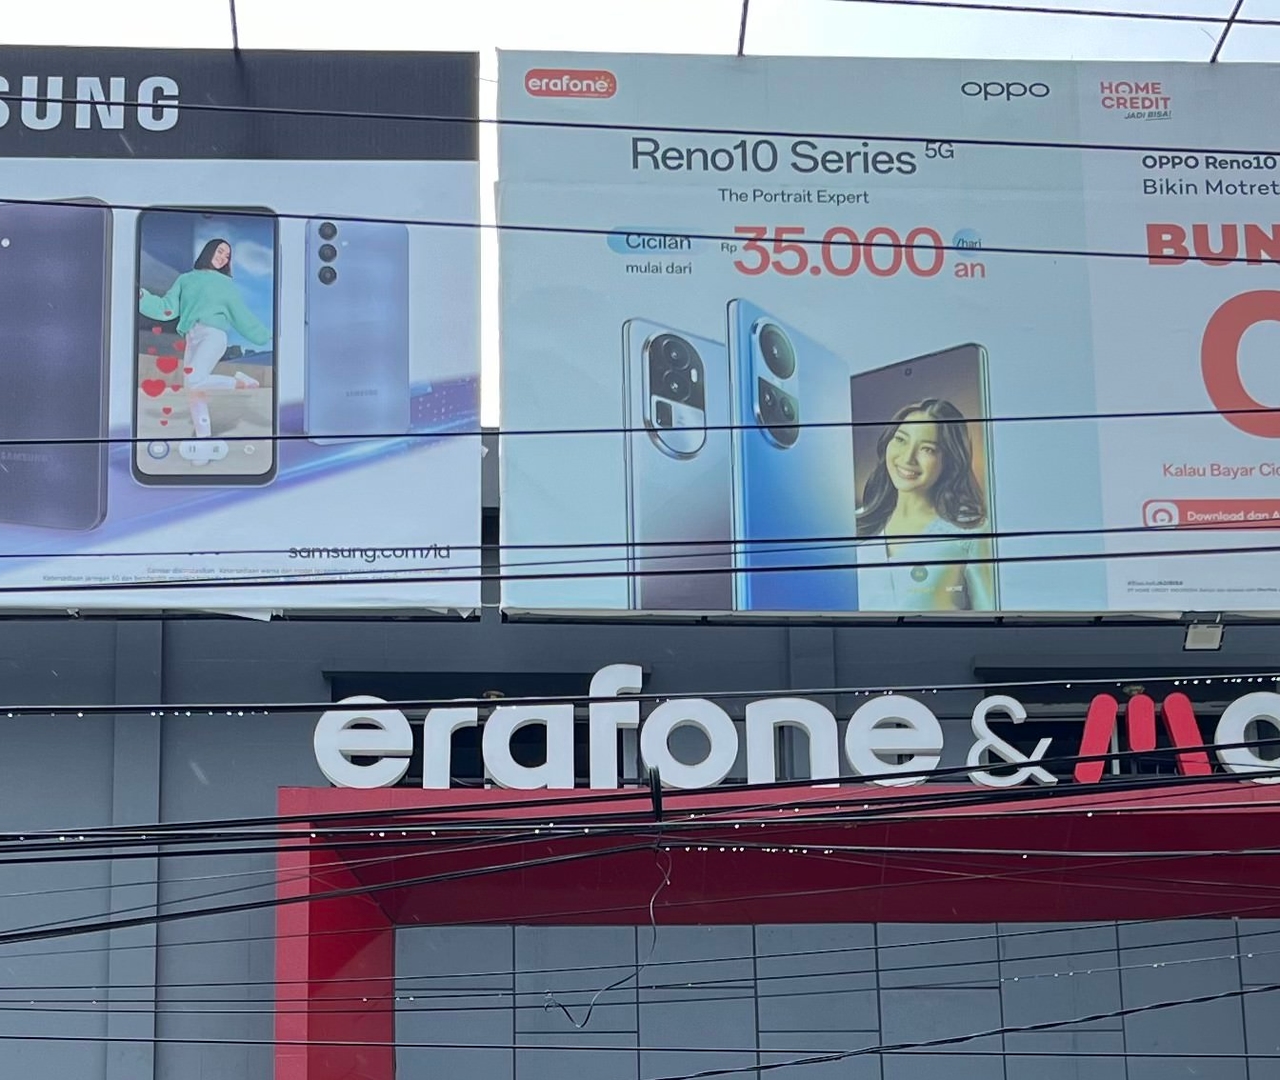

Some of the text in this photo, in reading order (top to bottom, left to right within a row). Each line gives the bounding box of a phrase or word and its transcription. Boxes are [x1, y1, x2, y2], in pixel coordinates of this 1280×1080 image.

[527, 75, 609, 93] erafone
[961, 81, 1050, 101] oppo
[1100, 81, 1162, 95] HOME
[1101, 96, 1171, 109] CREDIT
[1124, 111, 1146, 120] JADI
[631, 136, 955, 175] Reno10 Series 5G
[1142, 154, 1199, 170] OPPO
[1205, 155, 1277, 170] Reno10
[1142, 178, 1198, 196] Bikin
[1205, 179, 1280, 196] Motret
[718, 188, 870, 207] The Portrait Expert
[624, 232, 692, 251] Cicilan
[721, 242, 737, 254] Rp
[733, 225, 945, 277] 35.000
[625, 261, 663, 275] mulai
[665, 261, 693, 275] dari
[1162, 462, 1206, 477] Kalau
[1210, 463, 1255, 480] Bayar
[1186, 510, 1245, 522] Download
[288, 543, 451, 563] samsung.com/id
[313, 663, 945, 790] erafone
[966, 695, 1058, 787] &
